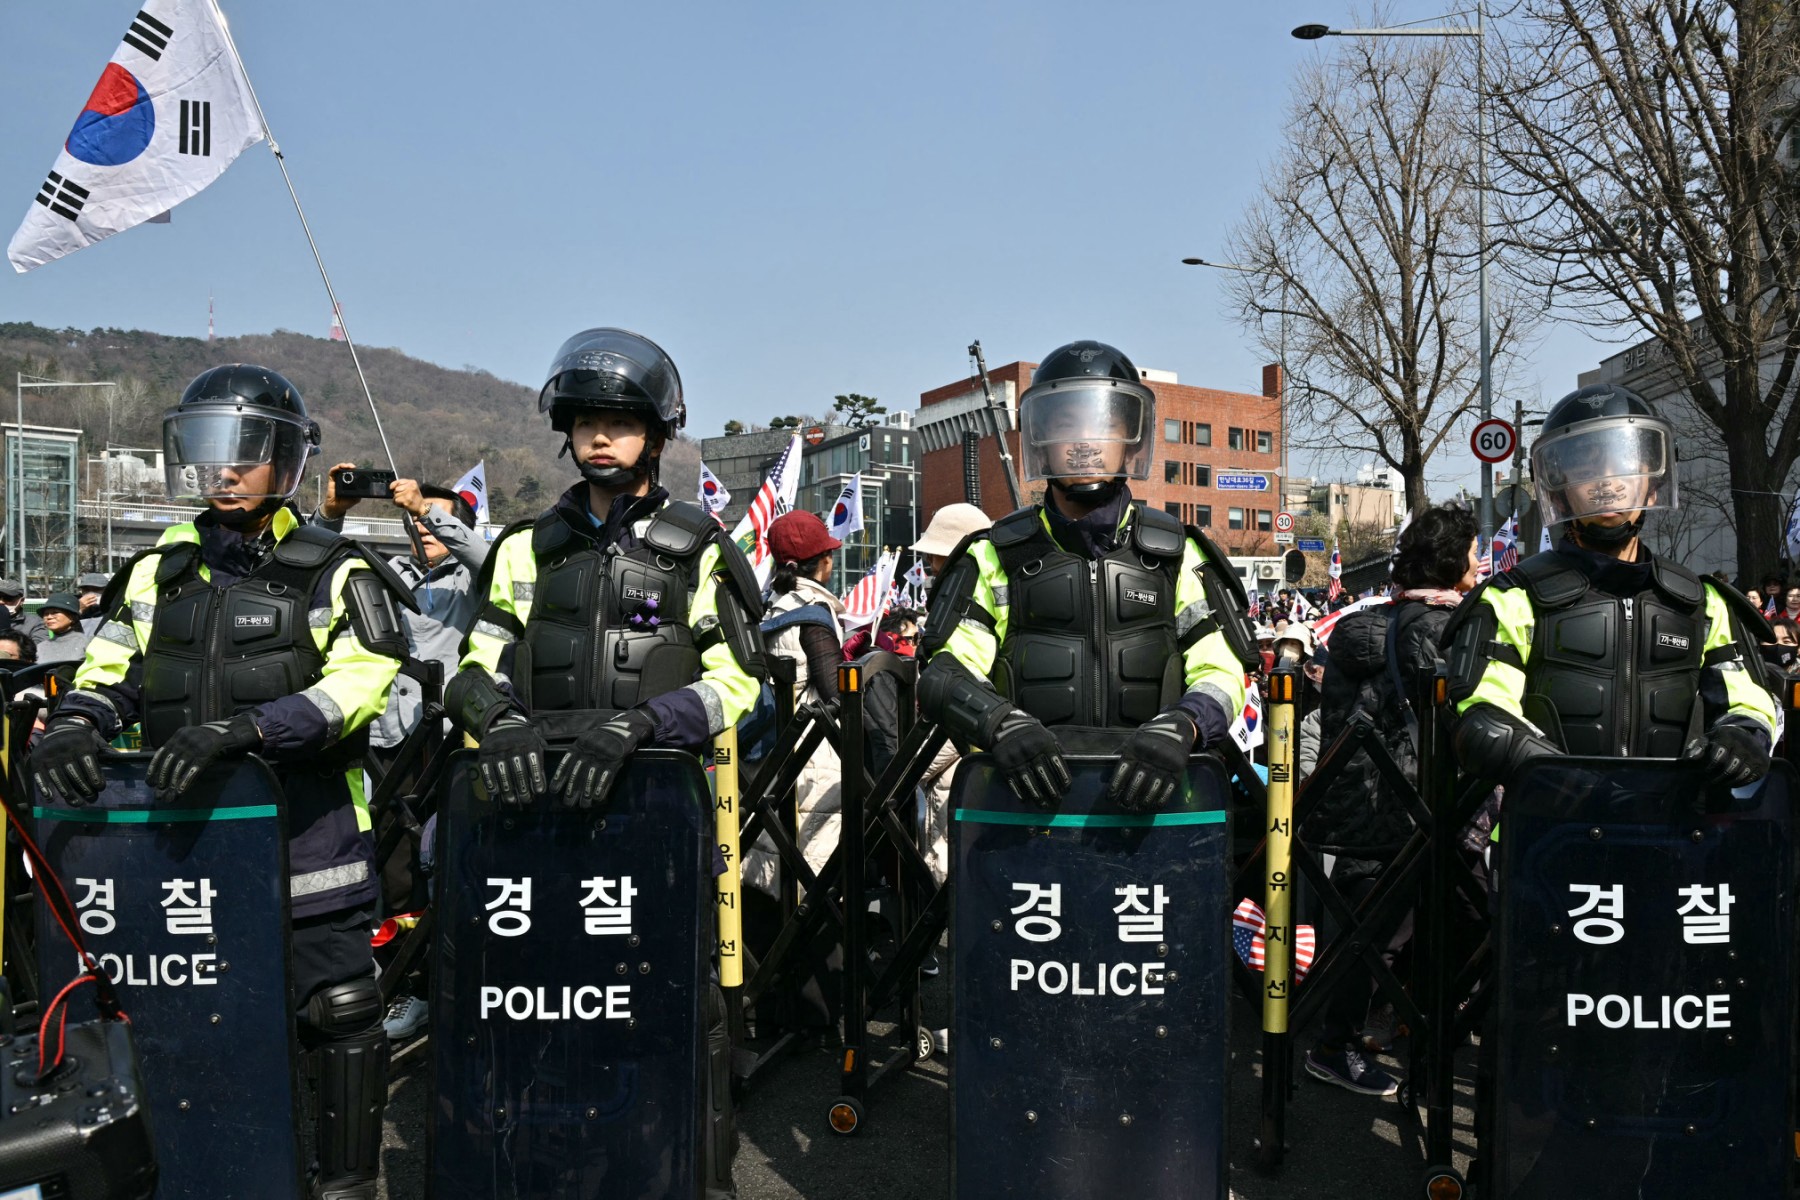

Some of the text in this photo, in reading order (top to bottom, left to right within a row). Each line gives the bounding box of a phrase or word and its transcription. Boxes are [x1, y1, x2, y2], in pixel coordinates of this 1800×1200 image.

[1480, 432, 1507, 451] 60
[1278, 517, 1290, 527] 30
[1010, 958, 1166, 997] POLICE
[480, 985, 632, 1021] POLICE
[1567, 993, 1732, 1030] POLICE
